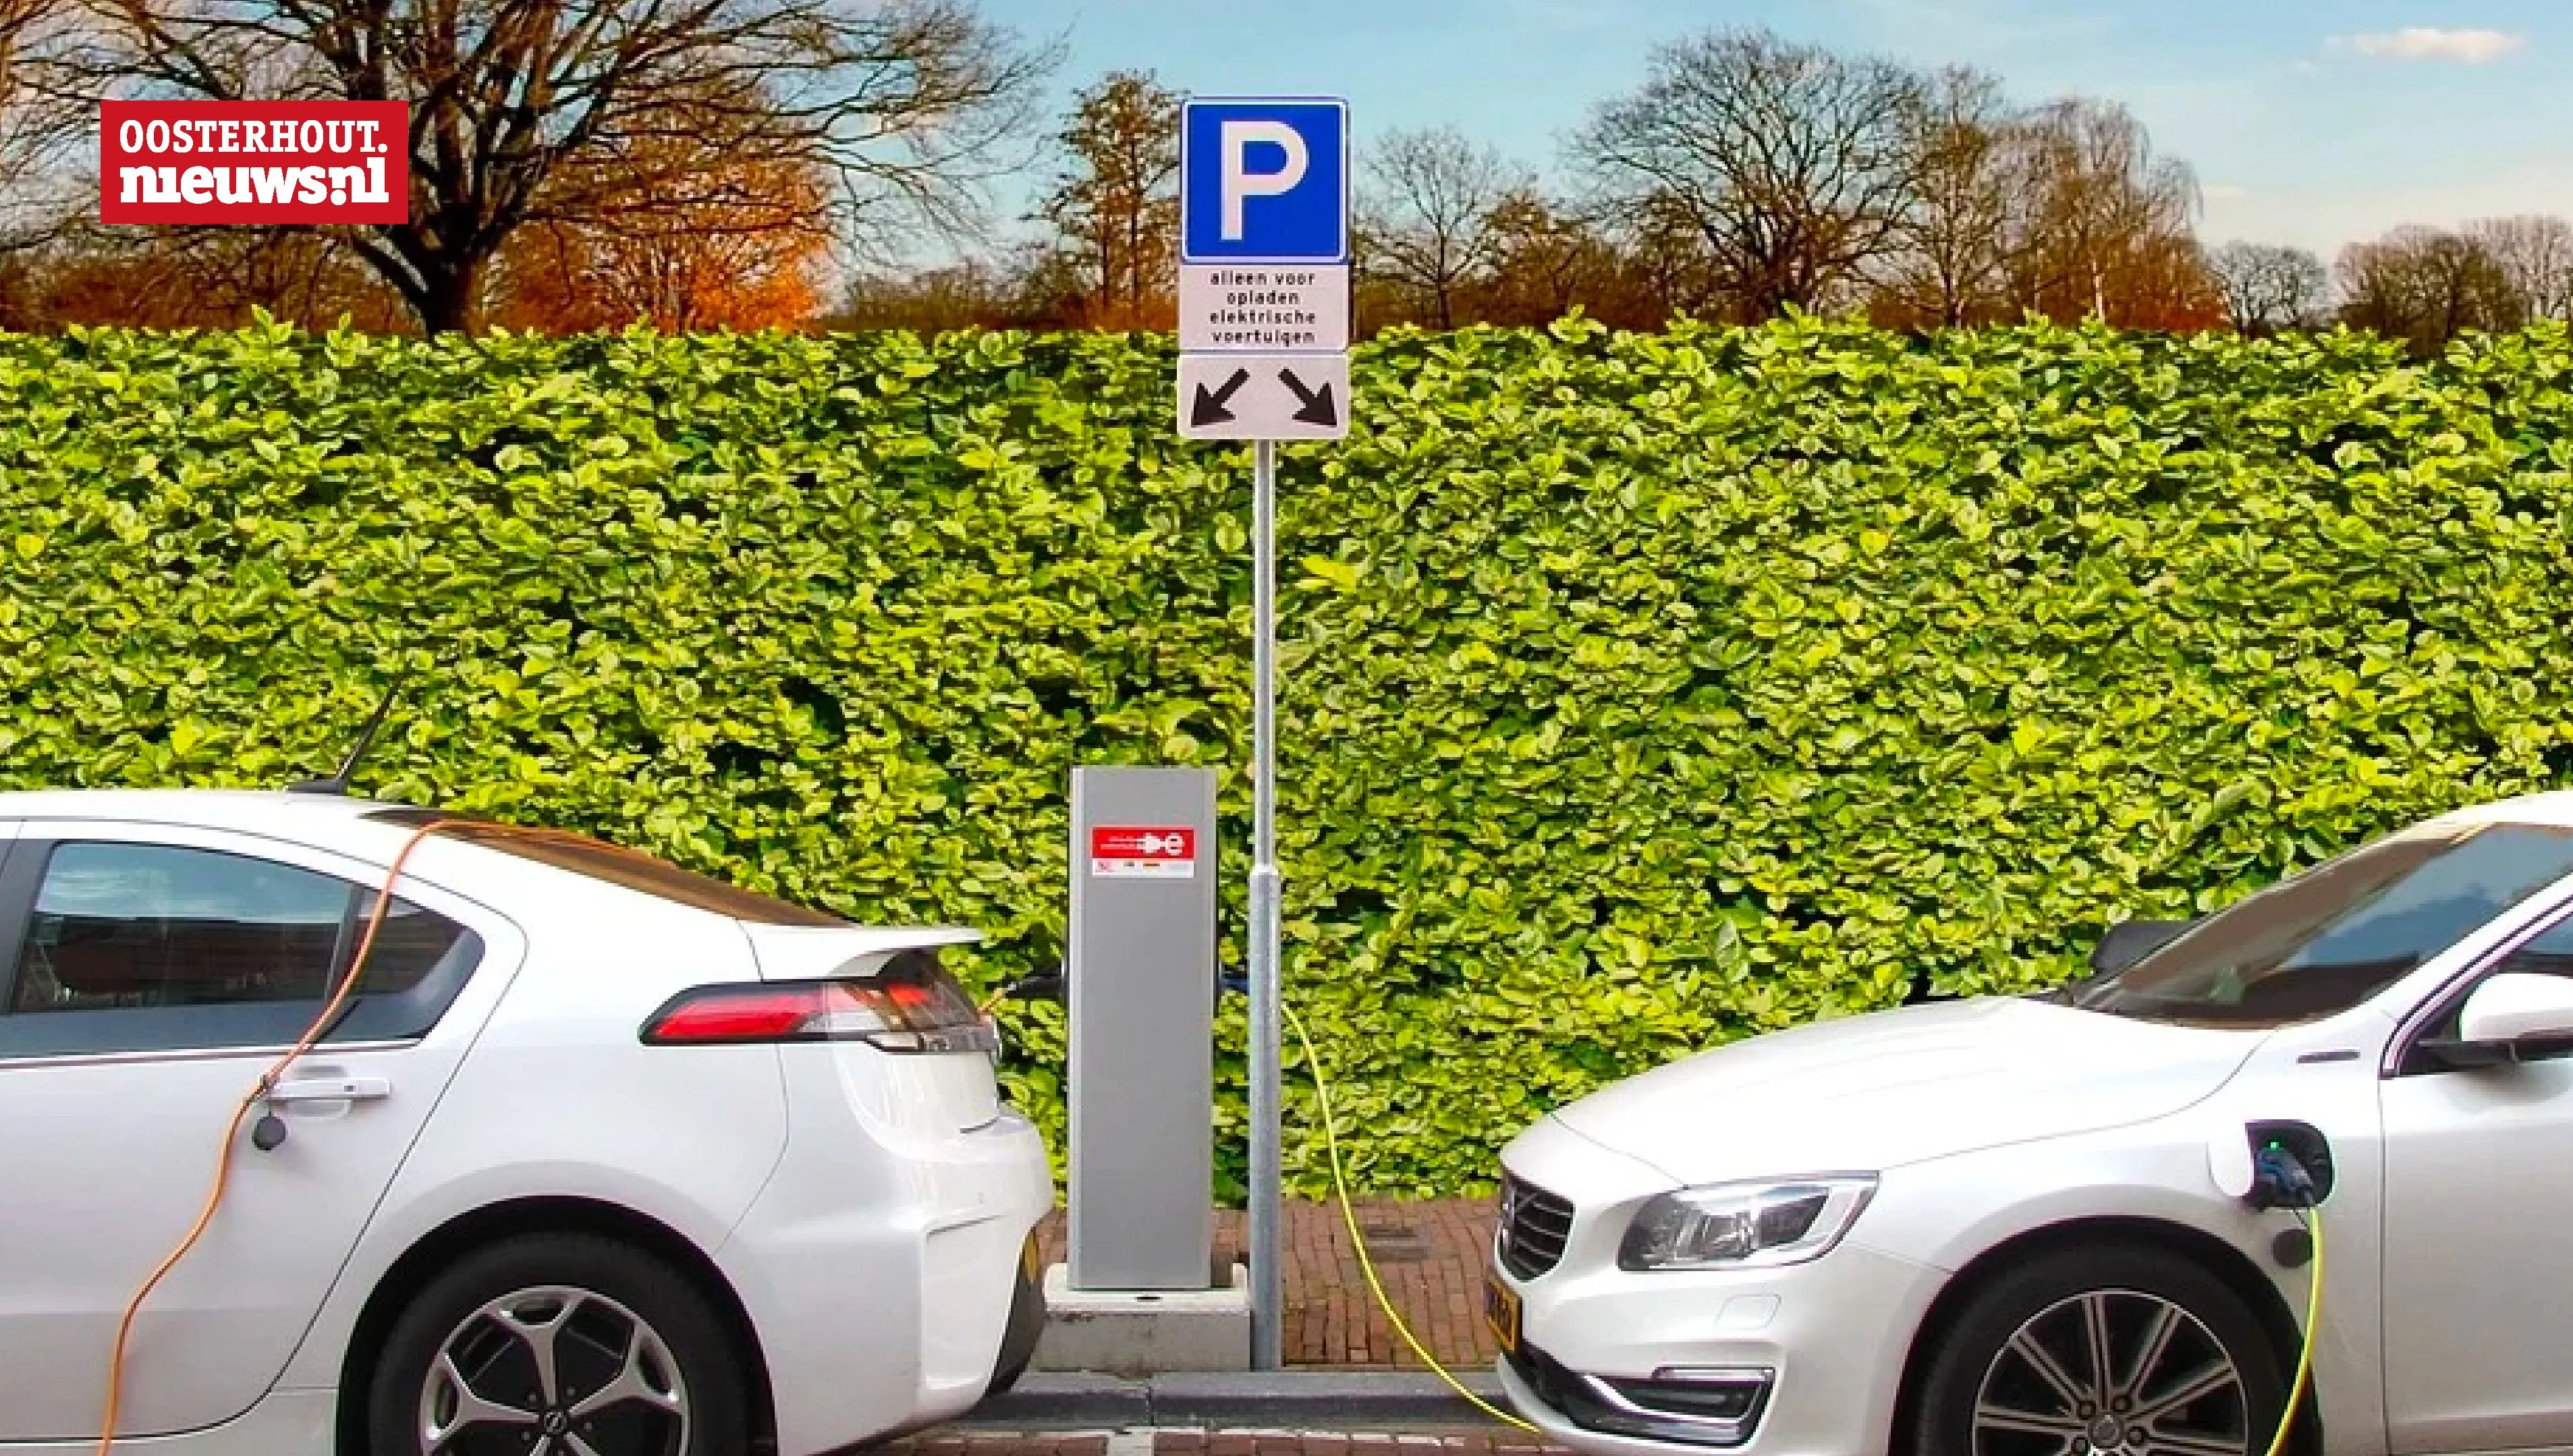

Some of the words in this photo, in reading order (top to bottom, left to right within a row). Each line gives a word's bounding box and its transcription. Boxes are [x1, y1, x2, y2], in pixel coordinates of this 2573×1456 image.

[1221, 121, 1309, 240] P
[1210, 270, 1267, 285] alleen
[1275, 273, 1315, 285] voor
[1227, 289, 1299, 308] opladen
[1210, 309, 1315, 325] elektrische
[1211, 329, 1315, 347] voertuigen
